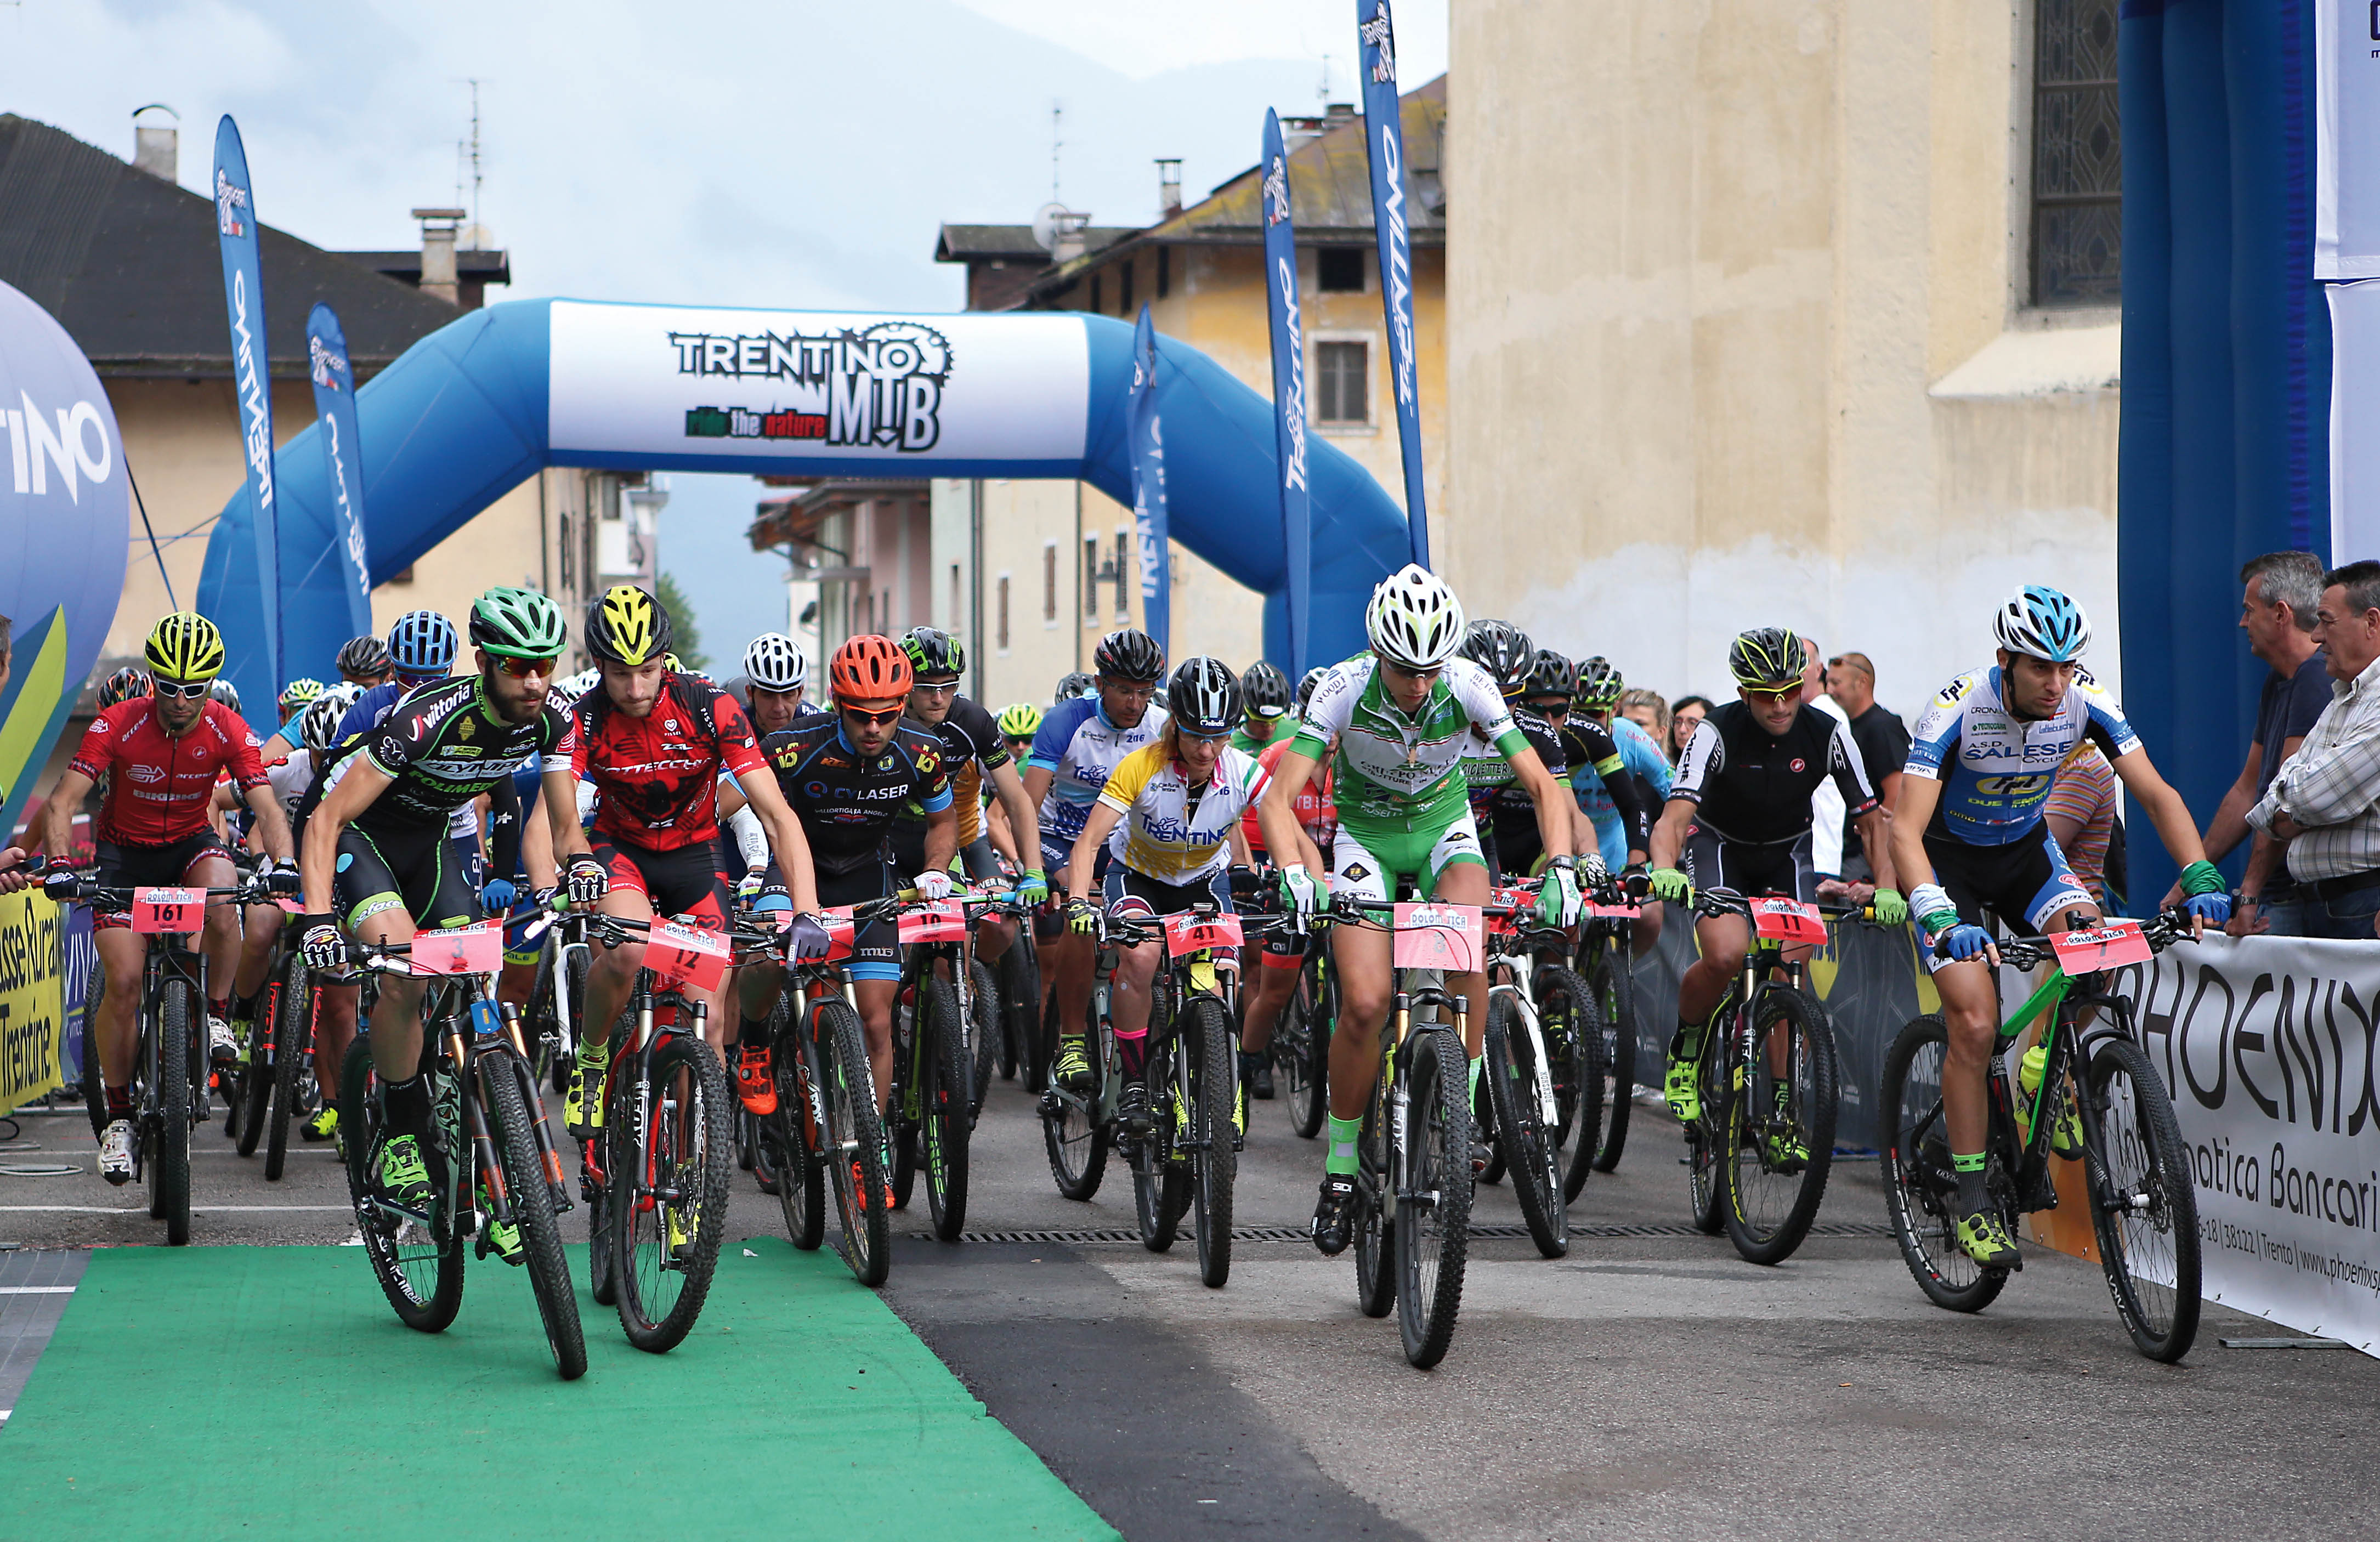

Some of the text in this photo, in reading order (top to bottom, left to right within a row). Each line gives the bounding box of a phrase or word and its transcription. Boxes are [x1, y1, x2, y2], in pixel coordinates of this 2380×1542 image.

[672, 329, 923, 379] TRENTINO
[730, 409, 762, 436] the
[766, 409, 827, 438] nature
[827, 373, 940, 452] MTB
[0, 388, 110, 506] INO
[422, 684, 470, 729] vittoria
[1964, 740, 2073, 760] SALESE
[1968, 741, 2005, 749] A.S.D.
[1679, 732, 1697, 784] MICHE
[835, 784, 909, 801] CYLASER
[1141, 812, 1233, 846] TRENTINO
[153, 905, 183, 921] 161
[1412, 914, 1466, 926] DOLOMTICA
[1764, 904, 1809, 915] DOLOMTICA
[430, 923, 486, 935] DOLOMTICA
[1180, 917, 1227, 928] DOLOMTICA
[1193, 926, 1214, 940] 41
[1780, 915, 1800, 931] 11
[666, 925, 715, 947] DOLOMTICA
[1434, 932, 1446, 954] 8
[2069, 929, 2124, 943] DOLOMTICA
[451, 938, 464, 958] 3
[675, 944, 701, 970] 12
[1540, 1072, 1552, 1103] ROCKSHOX
[809, 1093, 824, 1125] FOX
[633, 1096, 644, 1149] FOX
[1332, 1182, 1352, 1193] SIDI
[2224, 1224, 2255, 1254] 38122
[2262, 1233, 2293, 1265] Trento
